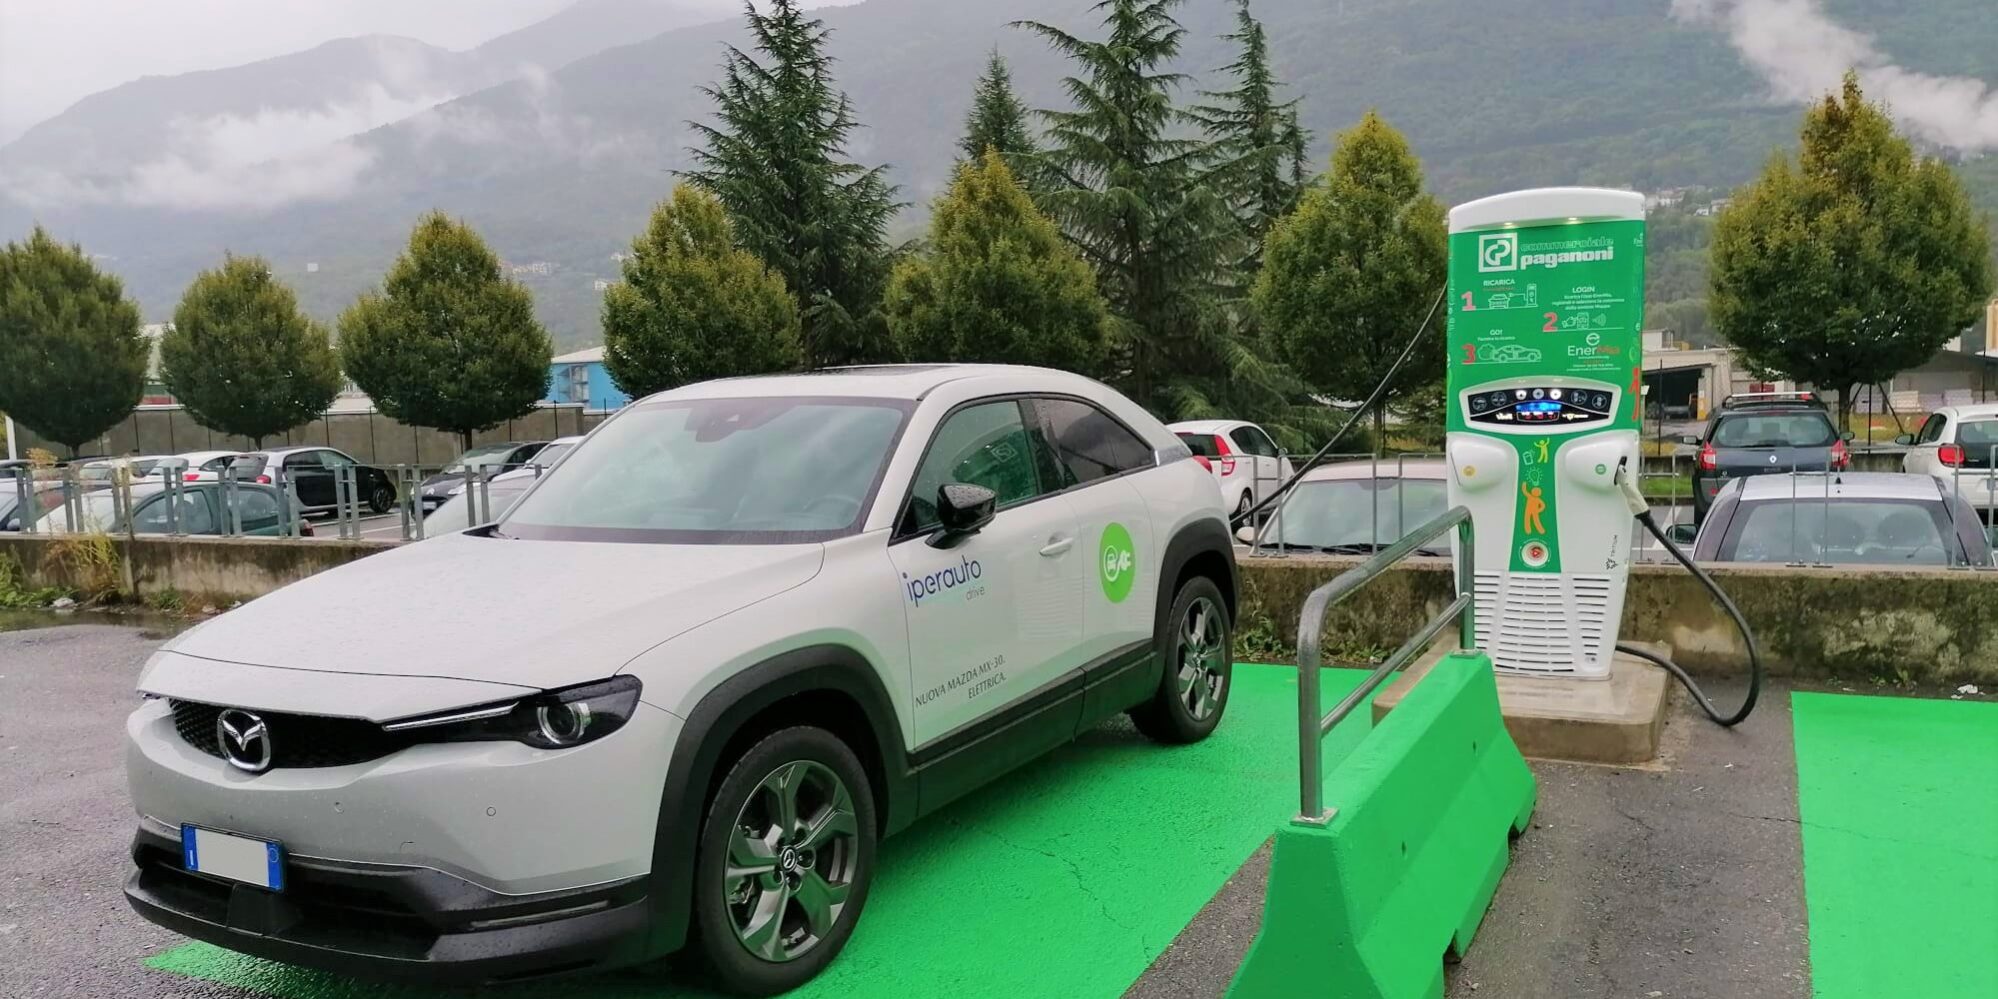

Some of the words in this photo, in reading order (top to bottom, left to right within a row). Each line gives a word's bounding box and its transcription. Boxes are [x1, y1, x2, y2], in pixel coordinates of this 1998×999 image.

[1520, 247, 1613, 270] paganoni
[1572, 286, 1596, 294] LOGIN
[1461, 292, 1475, 310] 1
[1543, 313, 1557, 331] 2
[1462, 345, 1475, 363] 3
[902, 555, 982, 607] iperauto
[965, 584, 986, 601] drive
[914, 684, 946, 708] NUOVA
[946, 667, 979, 692] MAZDA
[977, 654, 1006, 678] MX-30.
